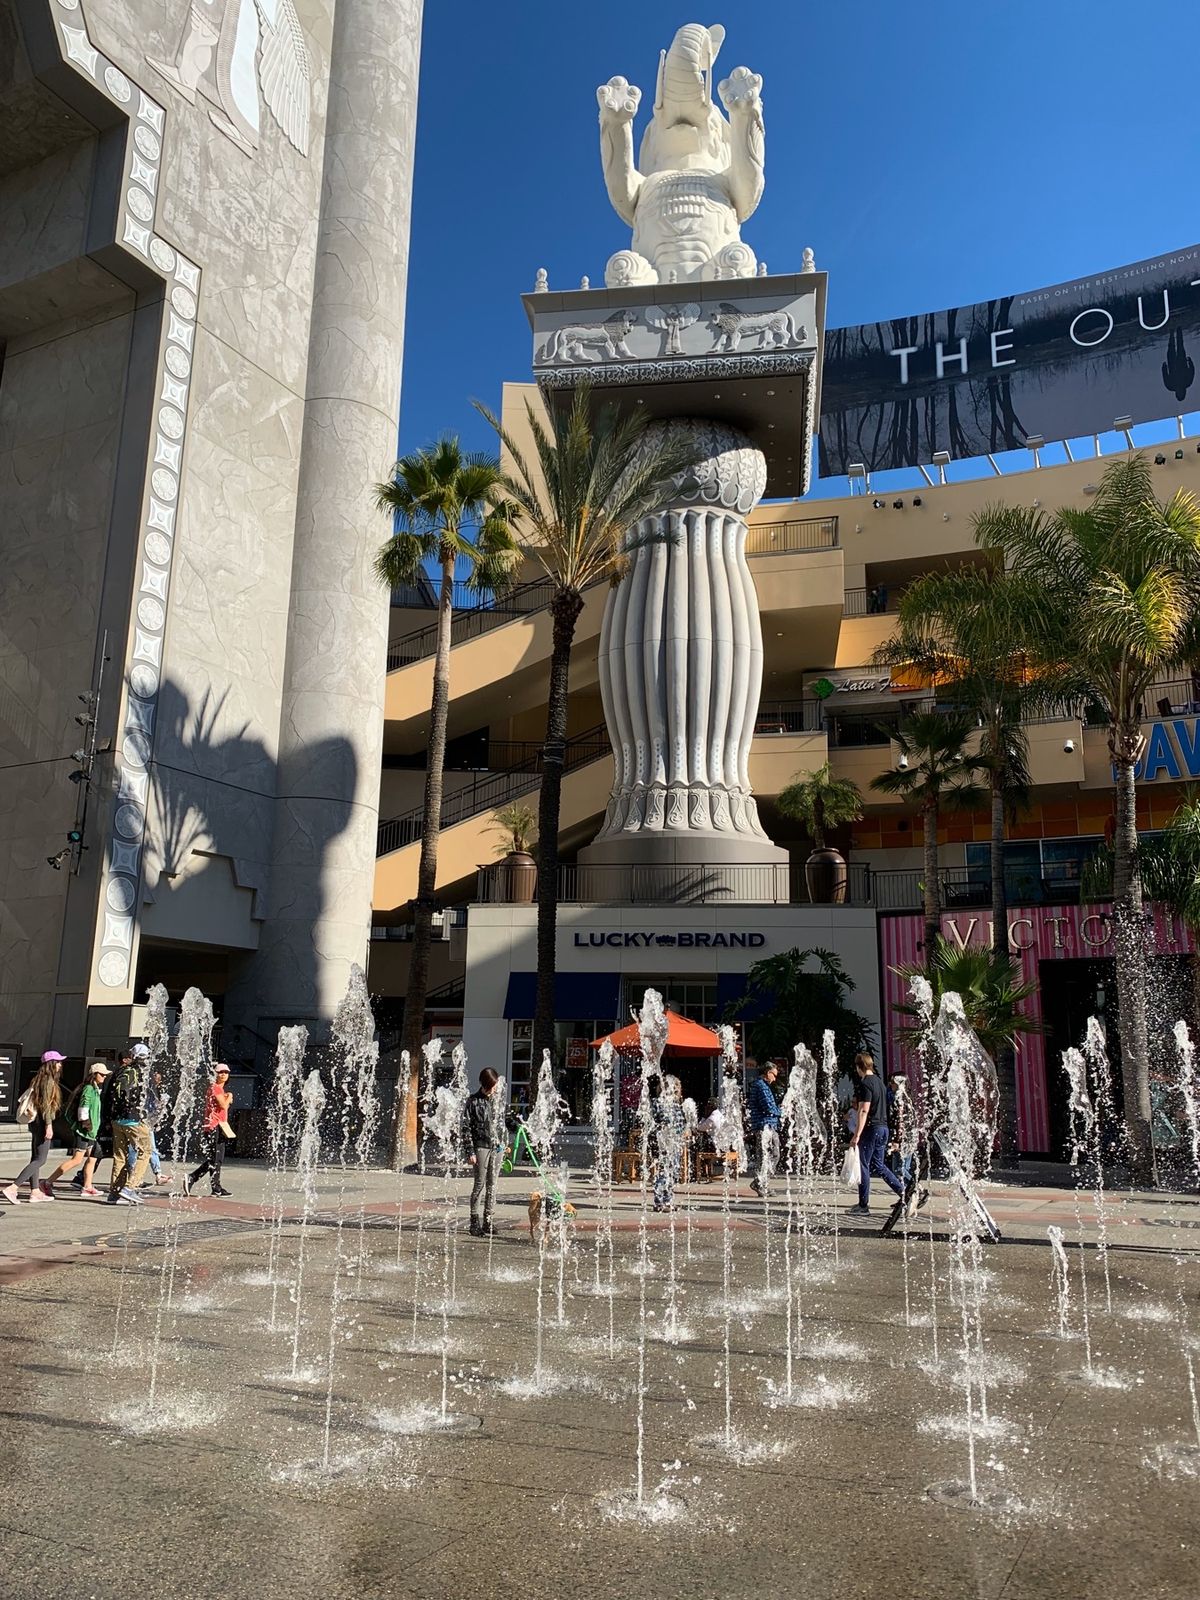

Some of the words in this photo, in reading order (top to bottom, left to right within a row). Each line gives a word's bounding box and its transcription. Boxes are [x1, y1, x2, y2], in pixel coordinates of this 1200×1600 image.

[1020, 293, 1050, 305] BASED
[1054, 288, 1069, 297] ON
[1073, 283, 1091, 292] THE
[1096, 261, 1165, 286] BEST-SELLING
[890, 329, 1016, 385] THE
[837, 678, 876, 692] Latin
[574, 932, 656, 947] LUCKY
[677, 932, 765, 947] BRAND
